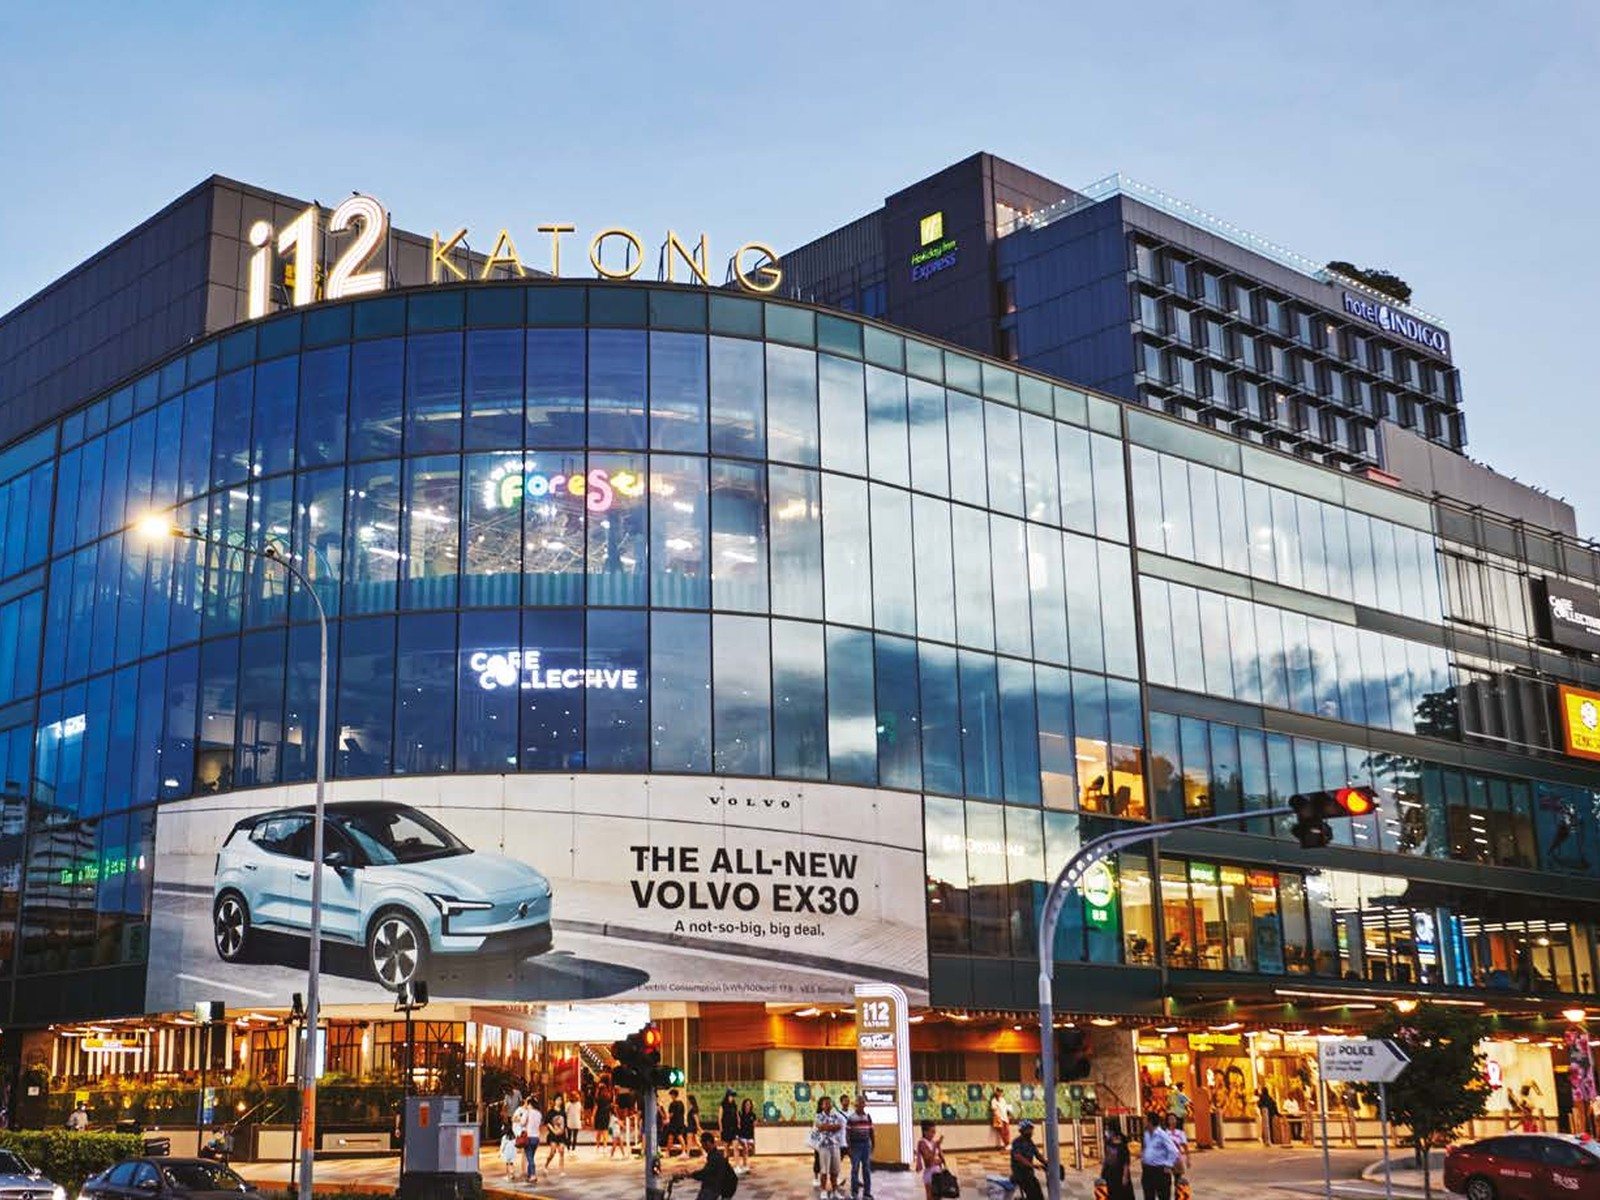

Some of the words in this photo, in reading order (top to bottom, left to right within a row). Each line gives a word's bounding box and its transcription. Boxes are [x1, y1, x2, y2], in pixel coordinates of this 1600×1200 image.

[248, 194, 388, 319] i12
[431, 224, 782, 292] KATONG
[913, 253, 956, 282] Express
[1343, 292, 1379, 325] hotel
[1390, 312, 1446, 351] INDIGO
[708, 796, 790, 809] VOLVO
[630, 846, 699, 873] THE
[710, 848, 858, 879] ALL-NEW
[630, 880, 760, 911] VOLVO
[772, 884, 860, 916] EX30
[674, 920, 685, 932] A
[689, 921, 766, 937] not-so-big,
[769, 922, 791, 938] big
[794, 923, 825, 936] deal.
[669, 982, 722, 994] Consumption
[862, 1001, 890, 1021] i12
[1339, 1045, 1375, 1057] POLICE
